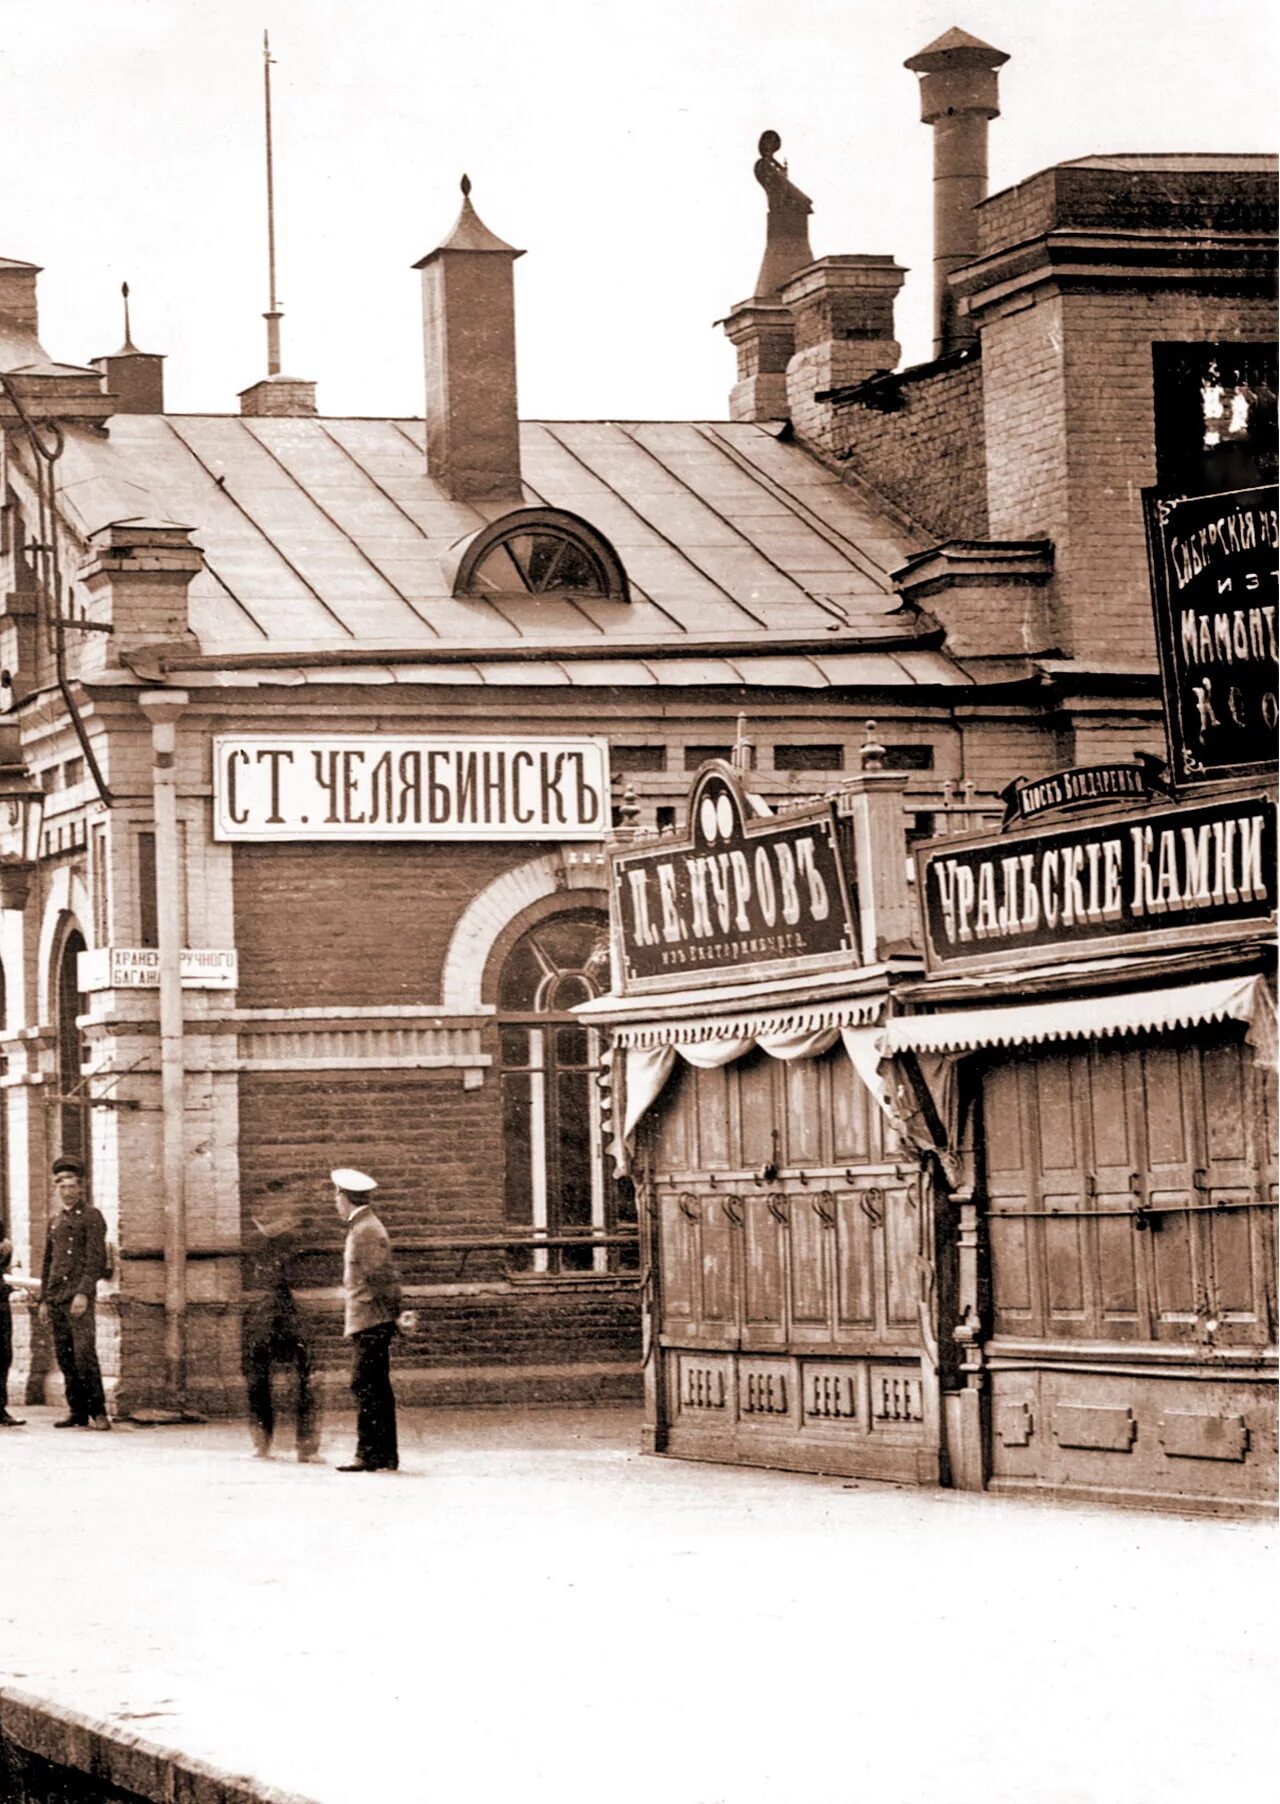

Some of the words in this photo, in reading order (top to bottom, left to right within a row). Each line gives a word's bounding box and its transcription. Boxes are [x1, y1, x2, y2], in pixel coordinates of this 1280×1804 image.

[227, 750, 309, 824] СТ.
[311, 750, 599, 824] ЧЕЛЯБИНСКЪ
[933, 838, 1123, 945] УРАЛЬСКІЕ
[1129, 814, 1268, 917] КАМНИ
